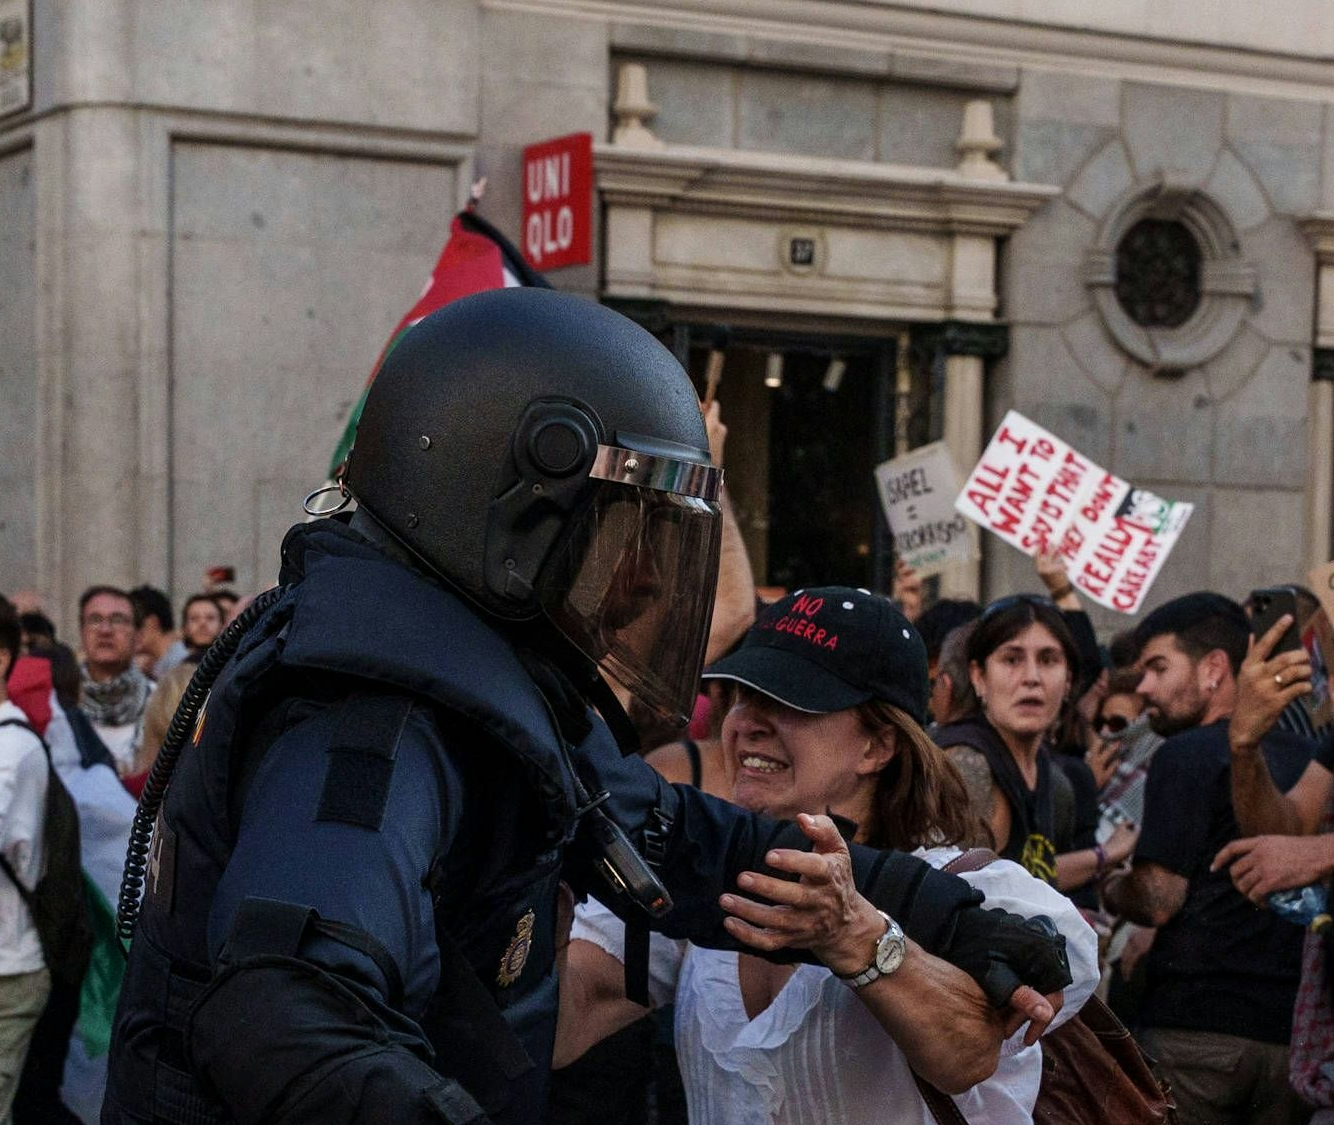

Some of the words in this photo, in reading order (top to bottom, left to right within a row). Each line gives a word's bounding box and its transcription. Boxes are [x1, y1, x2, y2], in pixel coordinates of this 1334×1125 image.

[527, 152, 570, 203] UNI
[527, 206, 573, 263] QLO
[967, 464, 1009, 518] ALL
[998, 427, 1028, 454] I
[991, 462, 1040, 535] WANT
[1030, 438, 1056, 461] TO
[1046, 452, 1088, 503] THAT
[1077, 516, 1137, 598] REALLY
[791, 593, 824, 617] NO
[774, 616, 839, 652] GUERRA
